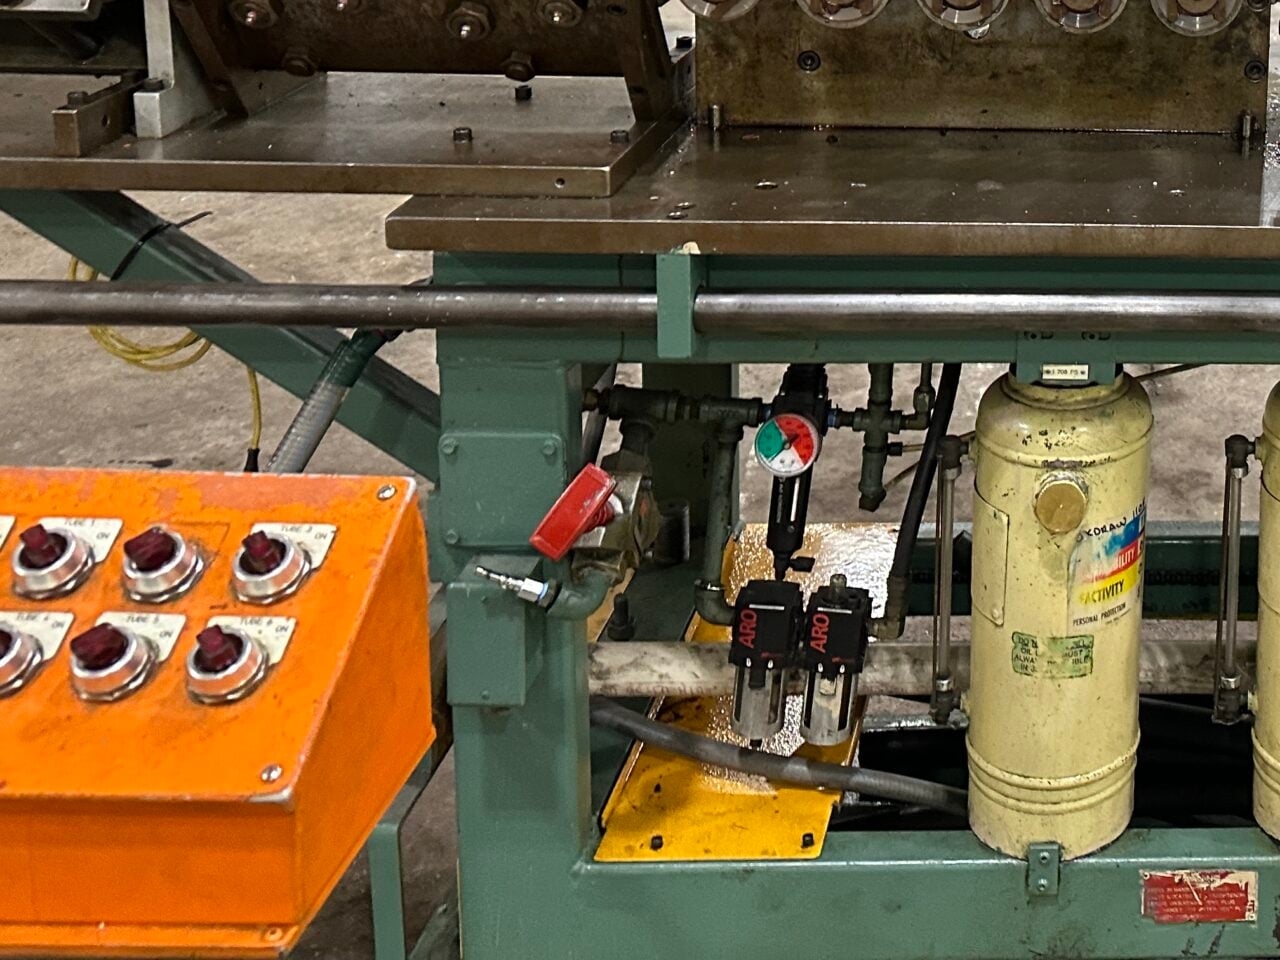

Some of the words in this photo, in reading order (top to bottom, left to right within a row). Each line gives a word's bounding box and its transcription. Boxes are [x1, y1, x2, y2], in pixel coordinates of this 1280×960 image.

[96, 532, 110, 540] ON
[314, 532, 328, 540] ON
[1072, 614, 1098, 627] PERSONAL
[1100, 602, 1126, 619] PROTECTION
[51, 621, 65, 629] ON
[275, 625, 289, 633] ON
[738, 608, 758, 649] ARO
[159, 631, 173, 639] ON
[810, 612, 830, 653] ARO
